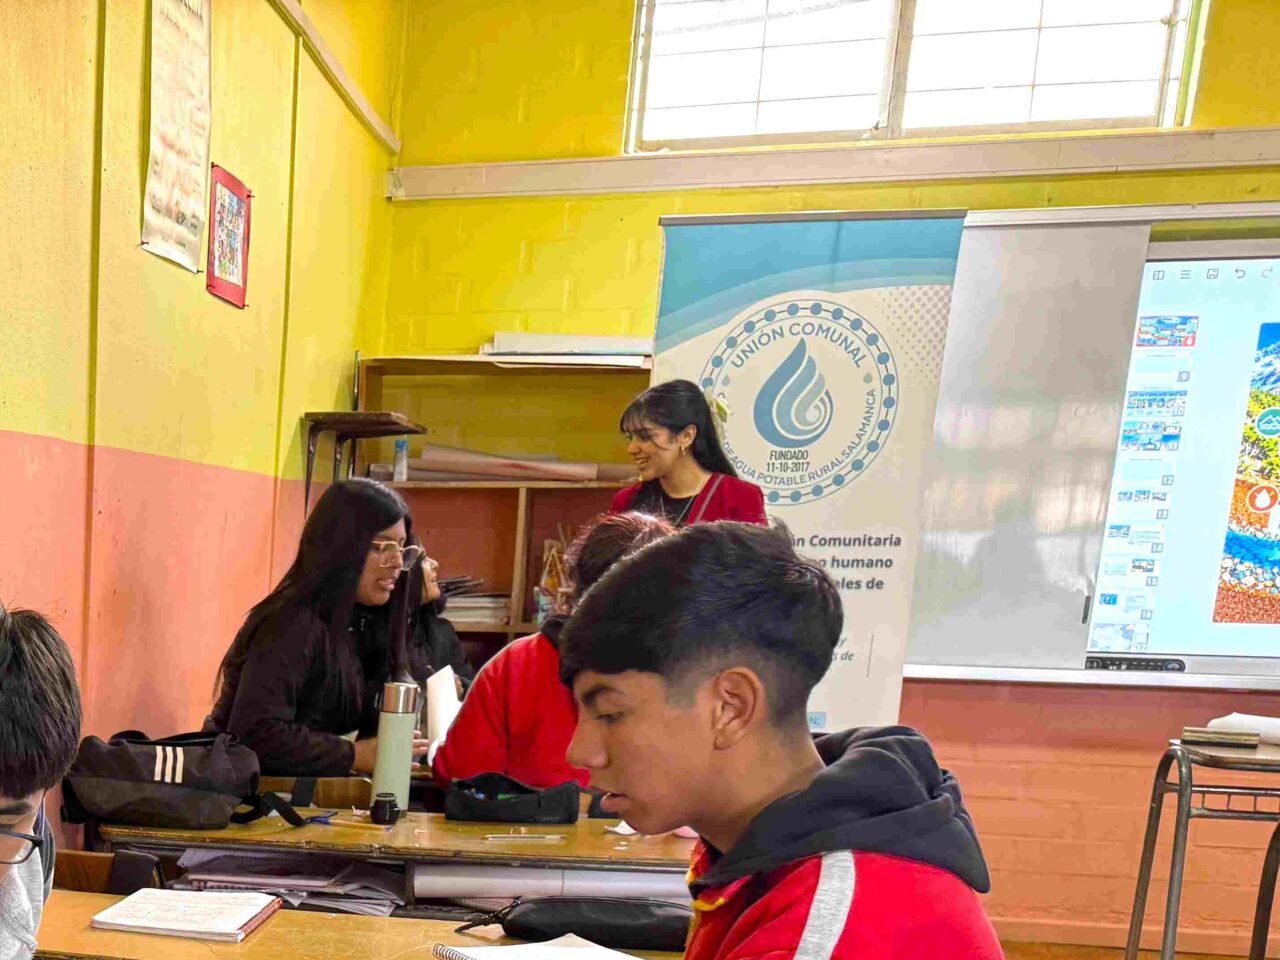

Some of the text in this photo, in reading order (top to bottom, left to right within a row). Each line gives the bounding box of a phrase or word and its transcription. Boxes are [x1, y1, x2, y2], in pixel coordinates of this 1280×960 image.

[731, 322, 868, 368] UNIÓN COMUNAL
[730, 457, 756, 480] AGUA
[757, 473, 806, 486] POTABLE
[808, 457, 847, 481] RURAL
[842, 388, 877, 459] SALAMANCA
[770, 449, 808, 460] FUNDADO
[766, 461, 810, 473] 11-10-2017
[810, 535, 902, 547] Comunitaria
[831, 556, 893, 568] humano
[866, 577, 884, 590] de
[840, 650, 854, 661] de
